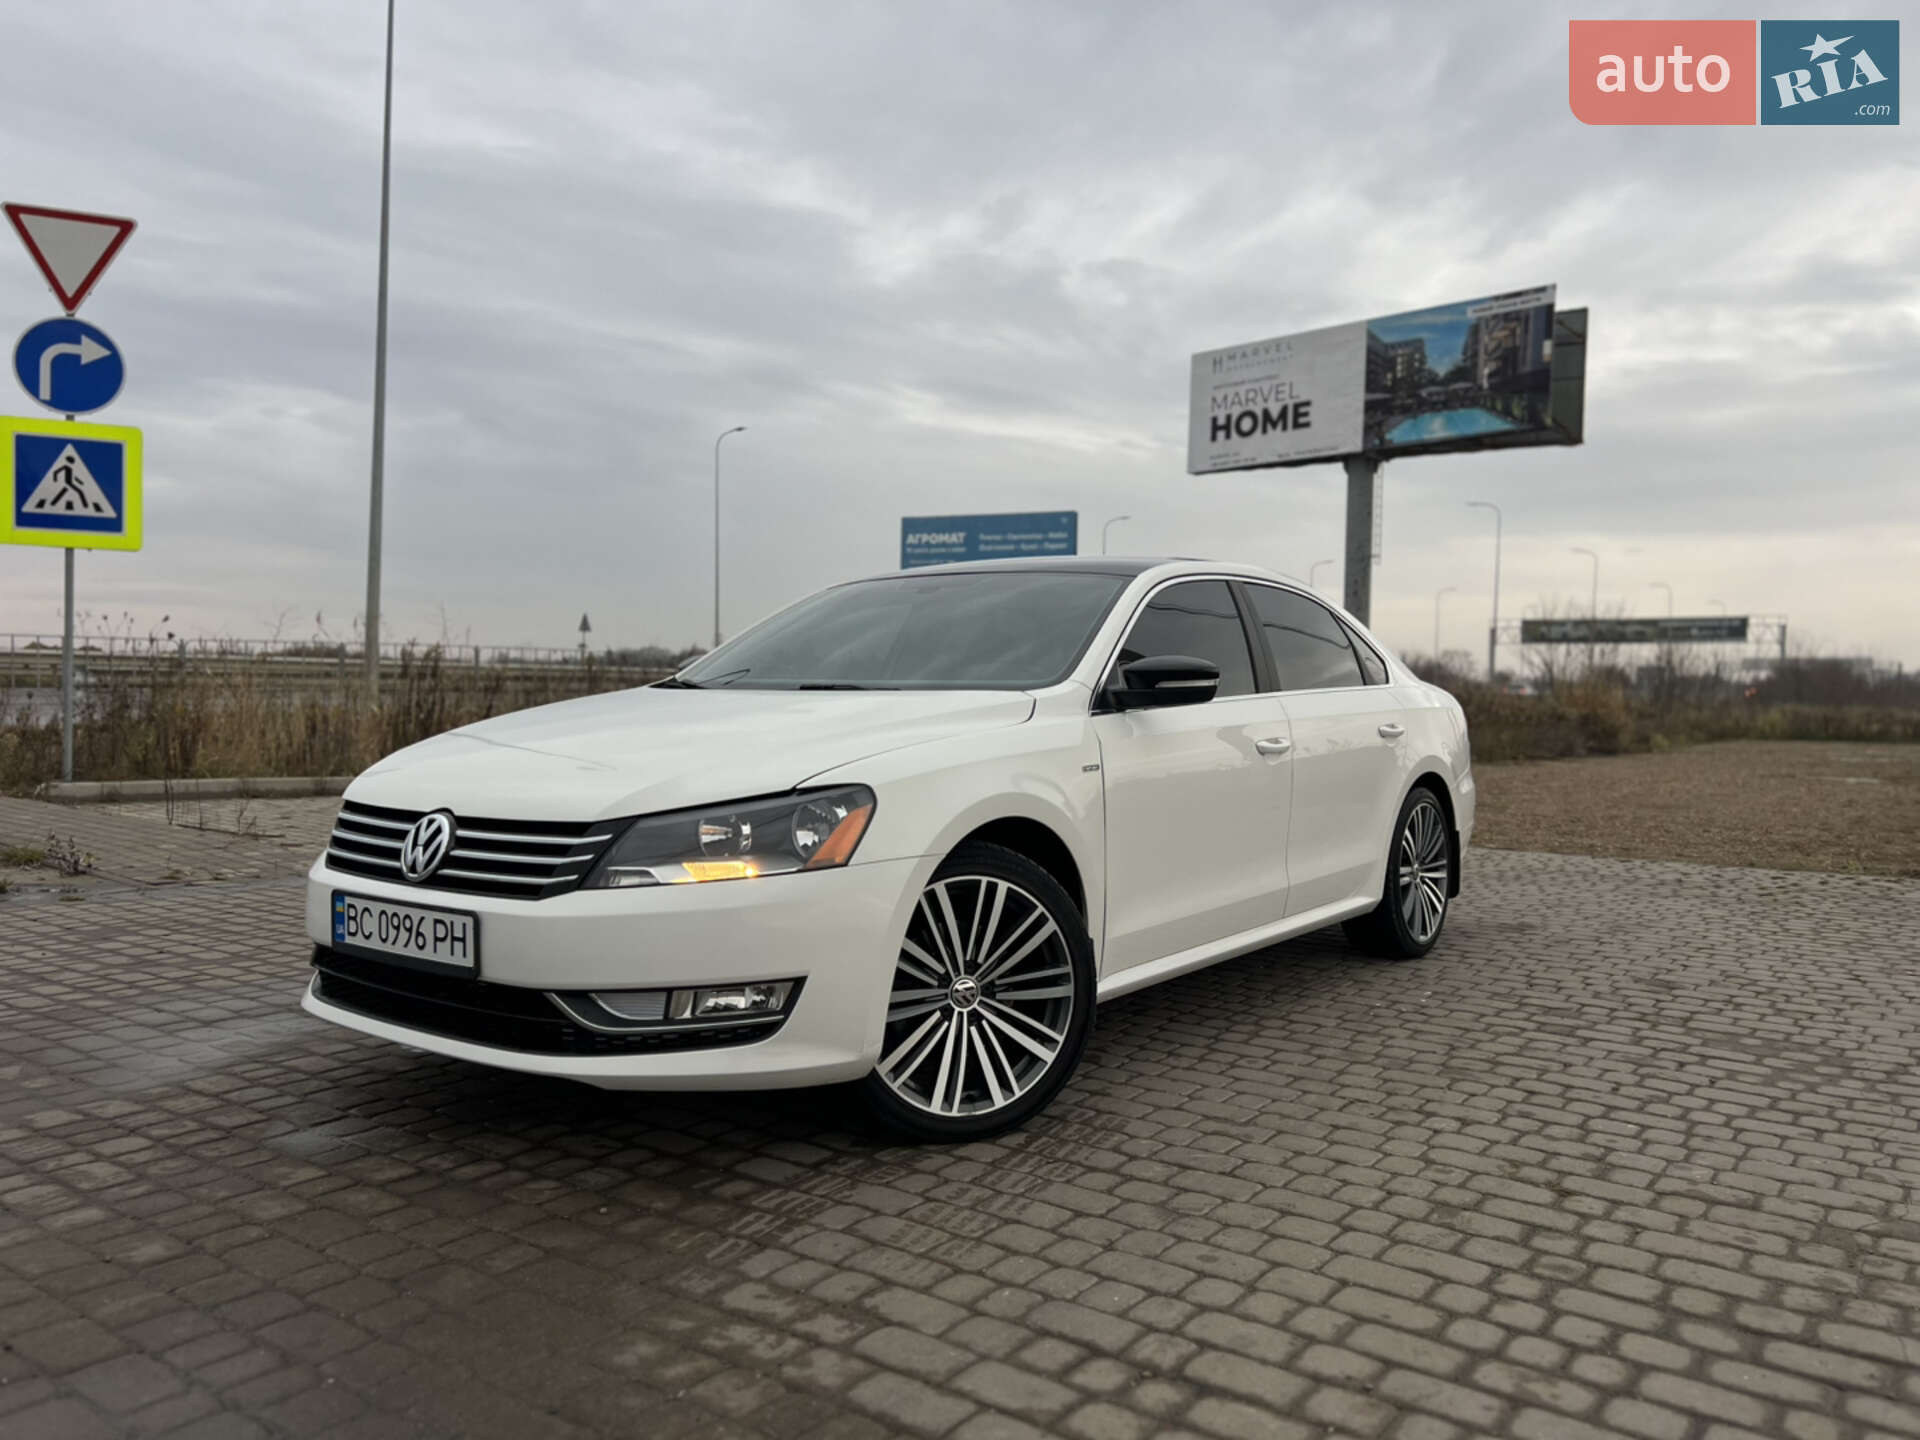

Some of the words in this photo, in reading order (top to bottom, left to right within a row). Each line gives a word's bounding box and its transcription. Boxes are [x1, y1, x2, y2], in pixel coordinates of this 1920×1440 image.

[1210, 381, 1301, 412] MARVEL
[1210, 400, 1312, 443] HOME
[906, 532, 967, 545] АГРОМАТ
[347, 903, 374, 940] BC
[378, 909, 426, 951] 0996
[433, 918, 467, 959] PH
